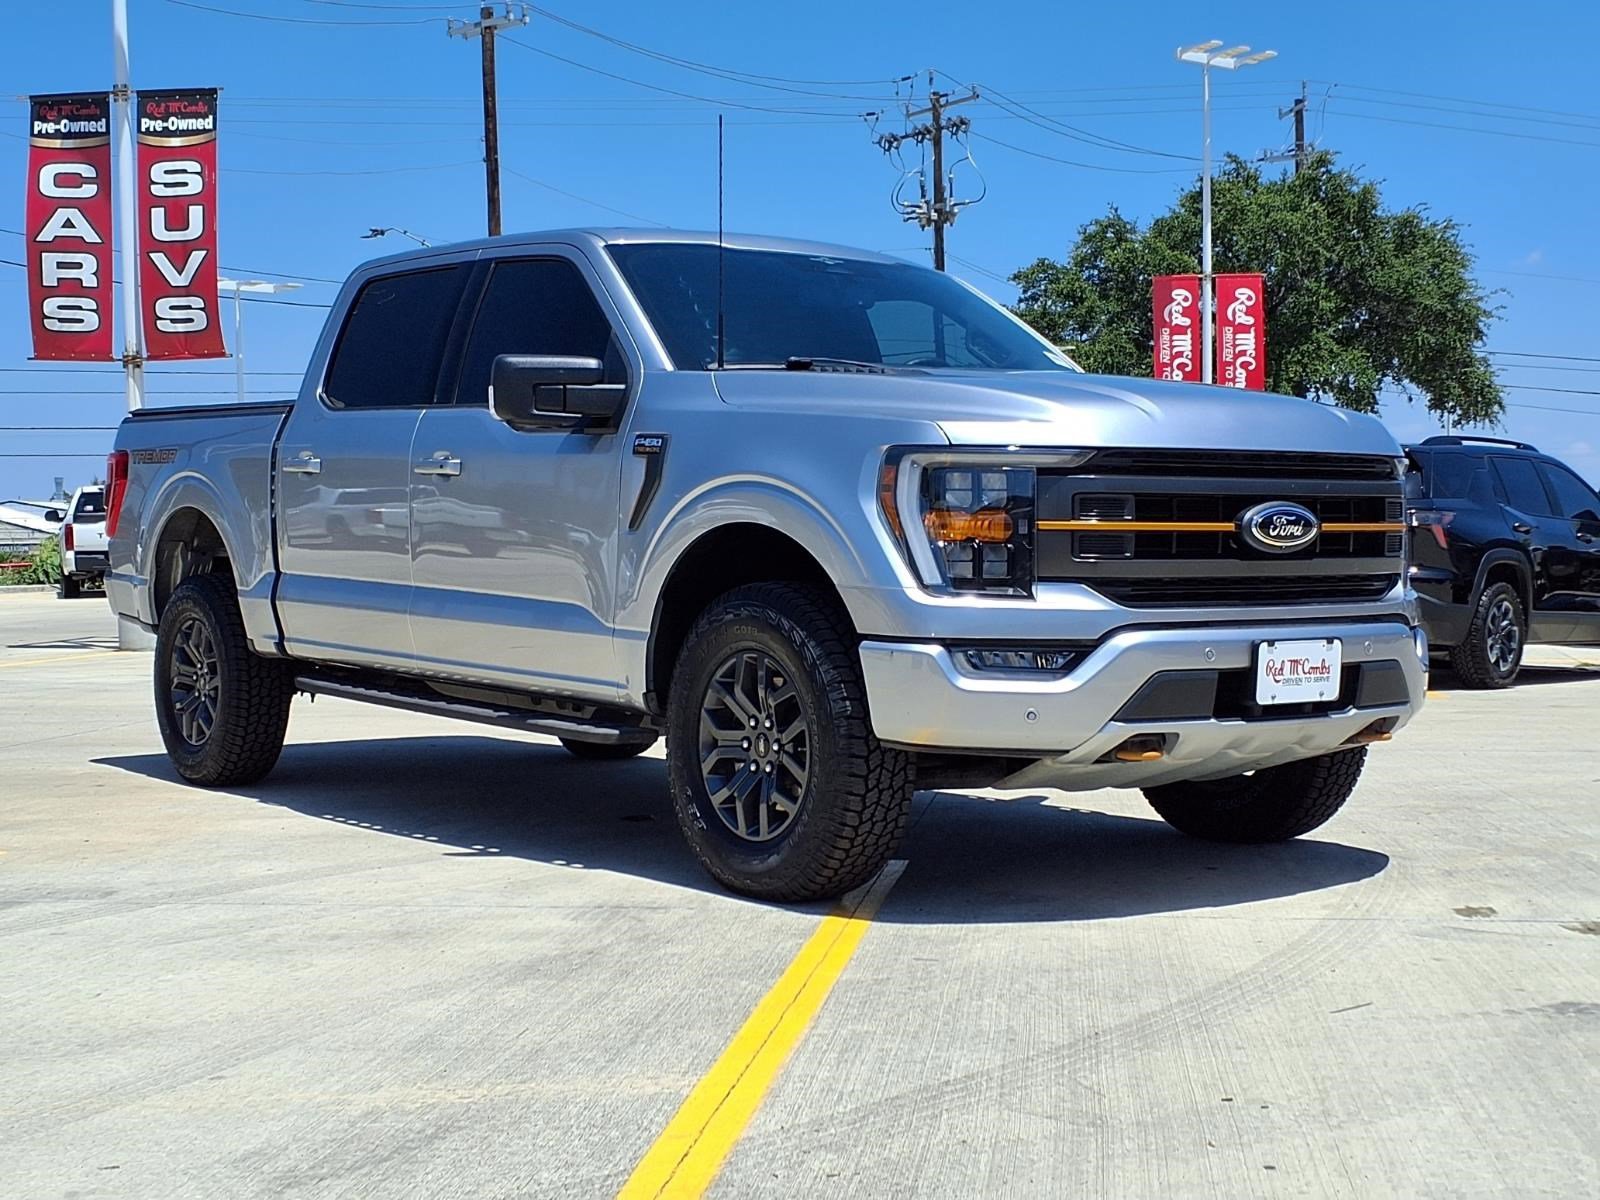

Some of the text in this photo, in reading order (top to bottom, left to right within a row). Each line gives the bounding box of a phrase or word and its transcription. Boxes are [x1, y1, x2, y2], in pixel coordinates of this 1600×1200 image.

[40, 105, 59, 120] Red
[146, 101, 208, 117] Red McCombs
[33, 118, 106, 135] Pre-Owned
[140, 115, 213, 132] Pre-Owned
[34, 162, 103, 333] CARS
[148, 160, 209, 333] SUVS
[1226, 287, 1256, 325] Red
[1161, 328, 1171, 364] DRIVEN
[1163, 288, 1193, 382] Red McCo
[1224, 326, 1234, 362] DRIVEN
[1224, 365, 1234, 379] TO
[131, 448, 177, 464] TREMOR
[1269, 514, 1305, 536] Ford
[1265, 658, 1332, 684] Red McCombs
[1282, 675, 1331, 686] DRIVEN TO SERVE
